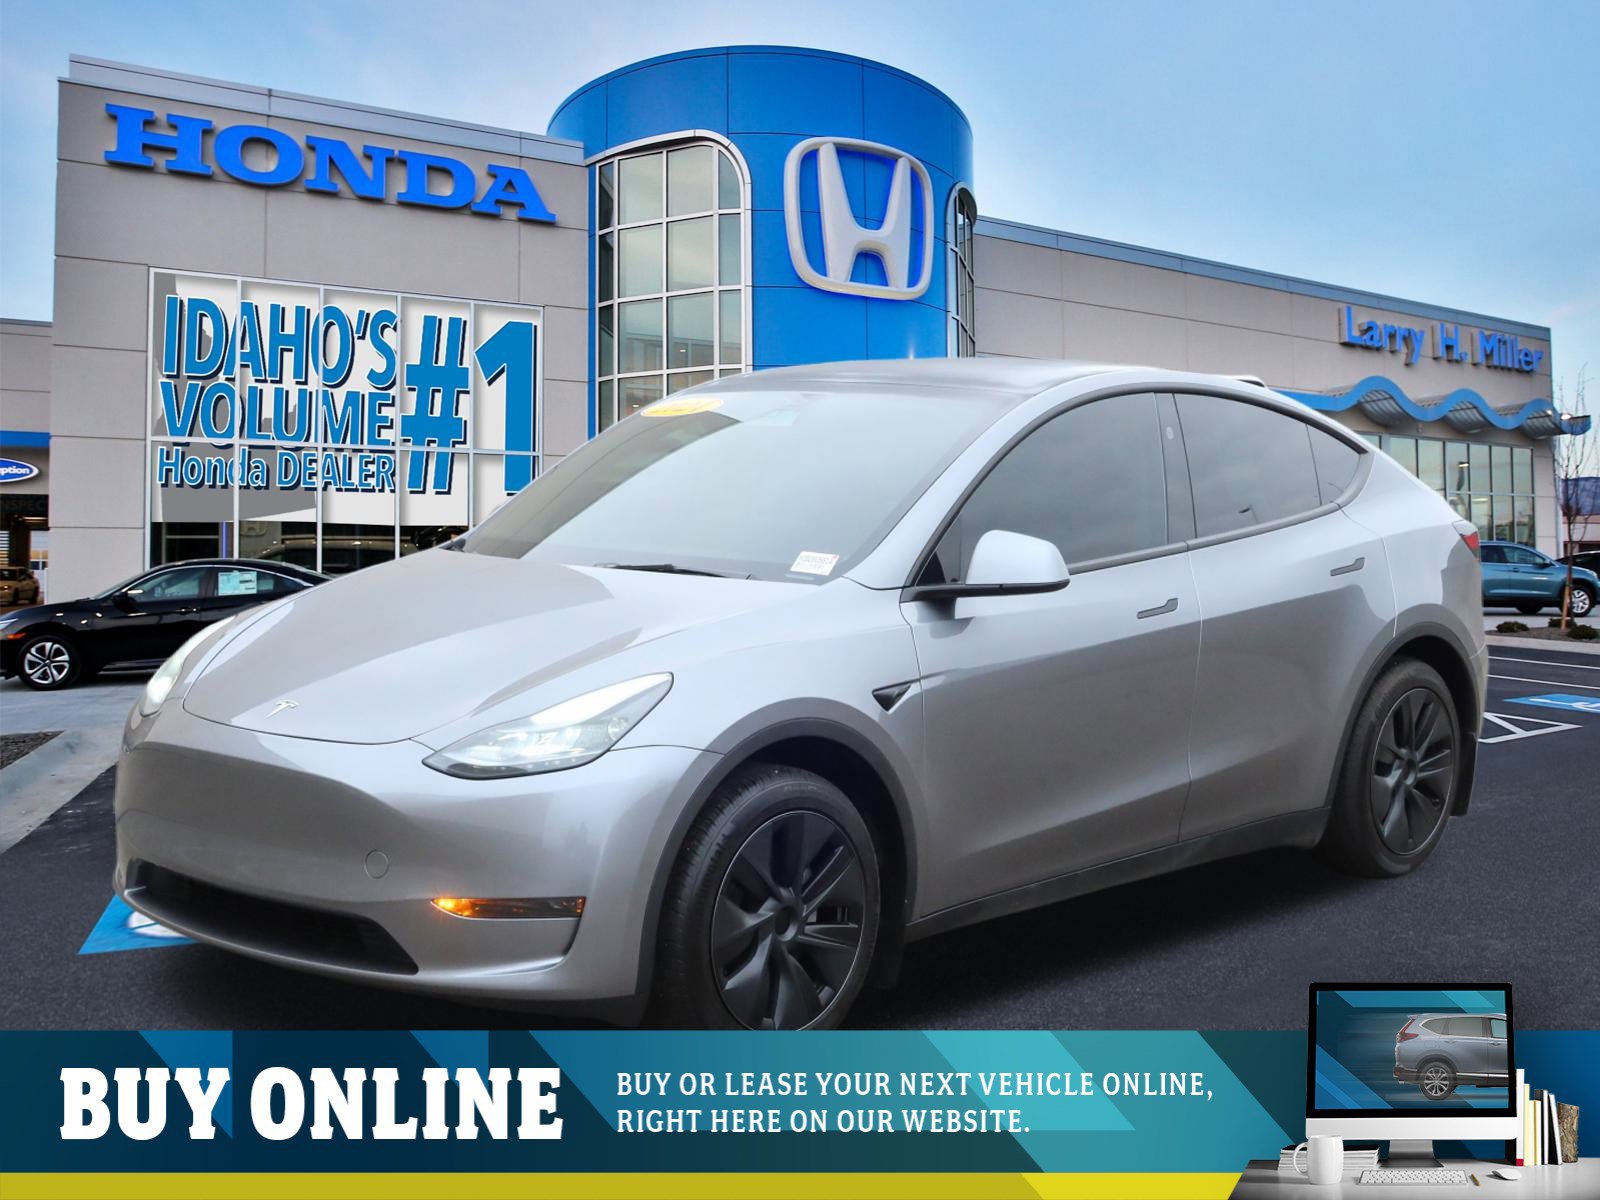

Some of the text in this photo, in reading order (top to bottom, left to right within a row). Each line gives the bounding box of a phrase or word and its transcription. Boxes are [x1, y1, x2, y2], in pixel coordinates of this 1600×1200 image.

[105, 103, 557, 223] HONDA
[163, 294, 399, 388] IDAHO'S
[1340, 305, 1544, 373] Larry H. Miller
[159, 381, 396, 446] VOLUME
[400, 315, 538, 496] #1
[0, 465, 30, 476] ption
[157, 446, 396, 493] Honda DEALER
